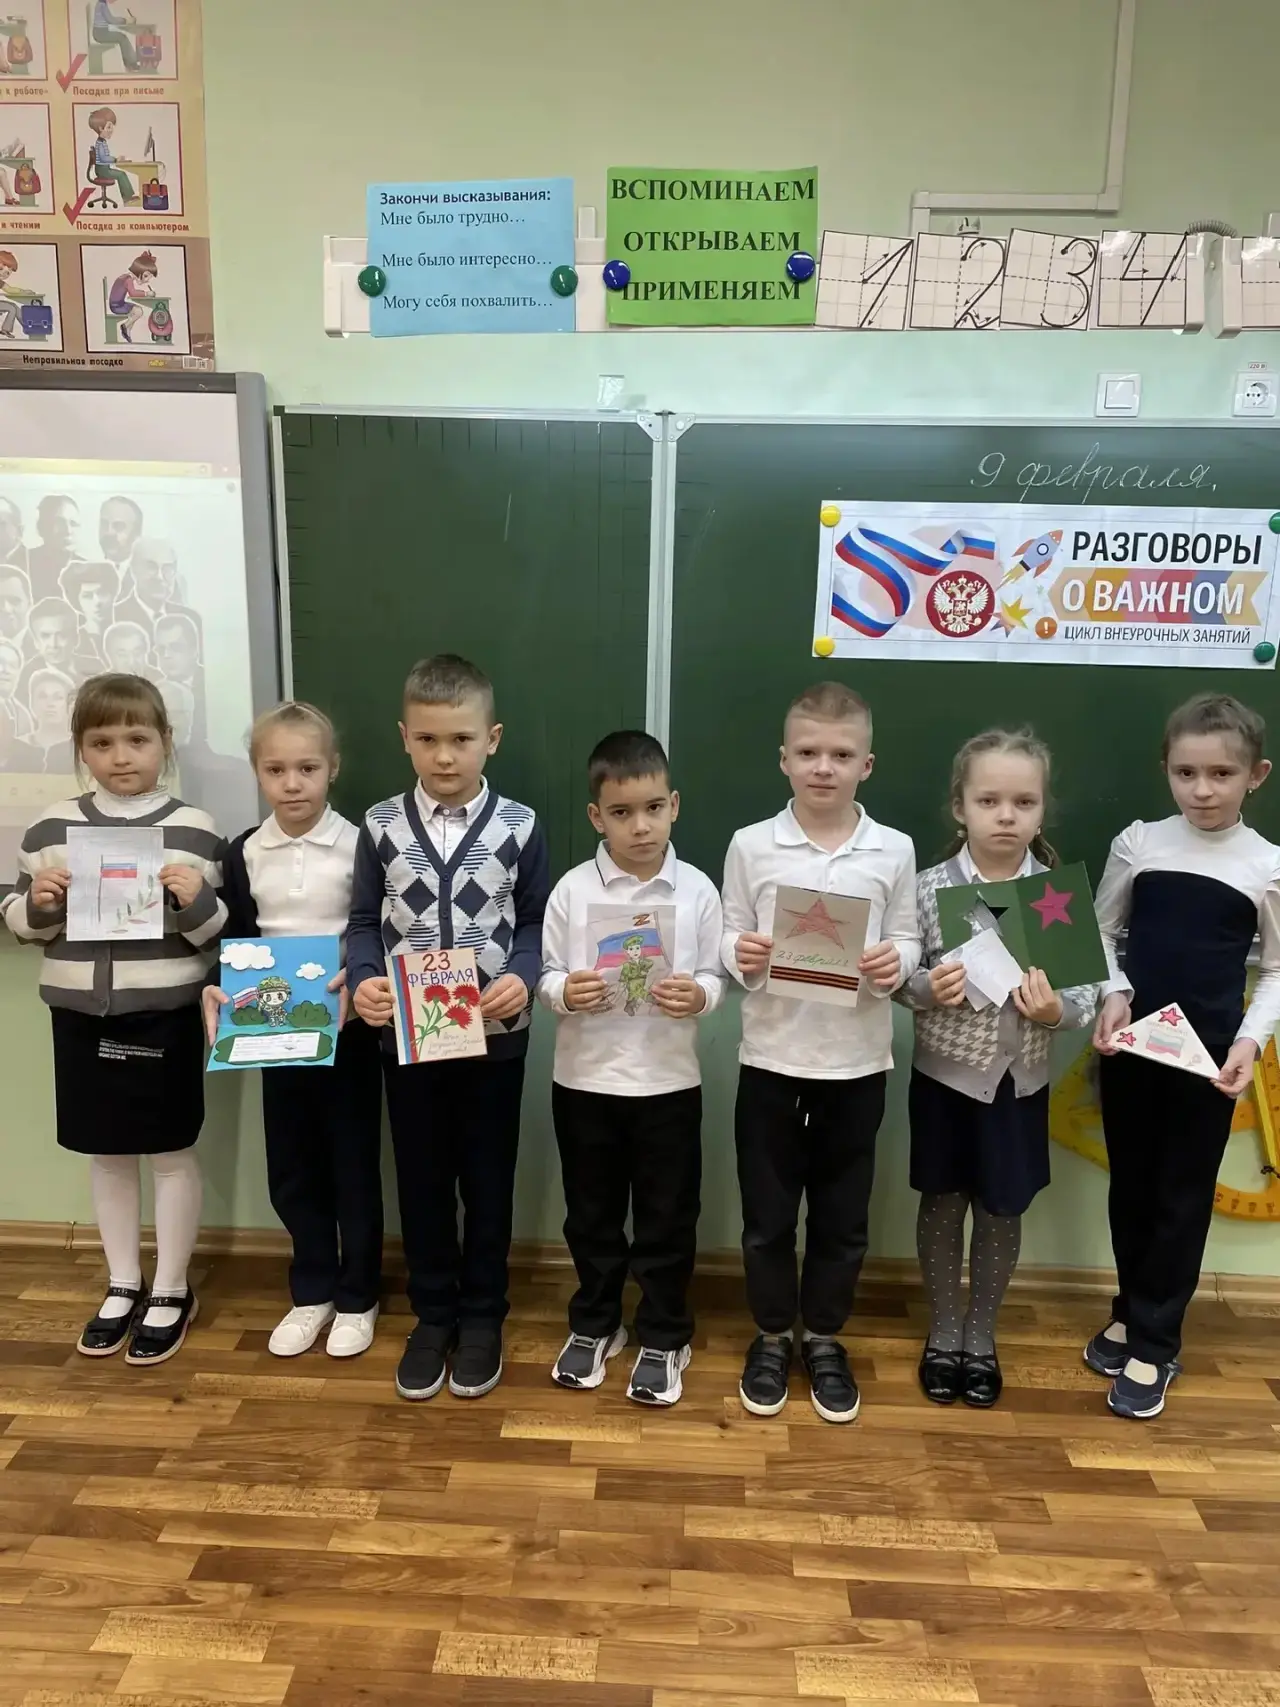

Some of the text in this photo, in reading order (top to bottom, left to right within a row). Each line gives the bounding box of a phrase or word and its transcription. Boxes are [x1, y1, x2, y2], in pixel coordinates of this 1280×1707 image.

[72, 86, 164, 97] Посадка при письме
[380, 190, 551, 205] Закончи высказывания:
[611, 178, 814, 202] ВСПОМИНАЕМ
[10, 221, 41, 230] чтении
[76, 220, 190, 233] Посадка за компьютером
[380, 212, 412, 226] Мне
[417, 211, 454, 225] было
[623, 230, 801, 252] ОТКРЫВАЕМ
[382, 254, 413, 267] Мне
[417, 252, 455, 267] было
[860, 231, 1188, 329] 1 2 3 4
[621, 280, 801, 301] ПРИМЕНЯЕМ
[383, 295, 421, 311] Могу
[425, 294, 456, 308] себя
[22, 354, 124, 367] Неправильная посадка
[970, 451, 1006, 487] 9
[1071, 530, 1262, 565] РАЗГОВОРЫ
[1062, 579, 1245, 615] О ВАЖНОМ
[1064, 626, 1250, 644] ЦИКЛ ВНЕУРОЧНЫХ ЗАНЯТИЙ
[422, 951, 451, 972] 23
[775, 950, 794, 960] 23
[407, 968, 475, 987] ФЕВРАЛЯ
